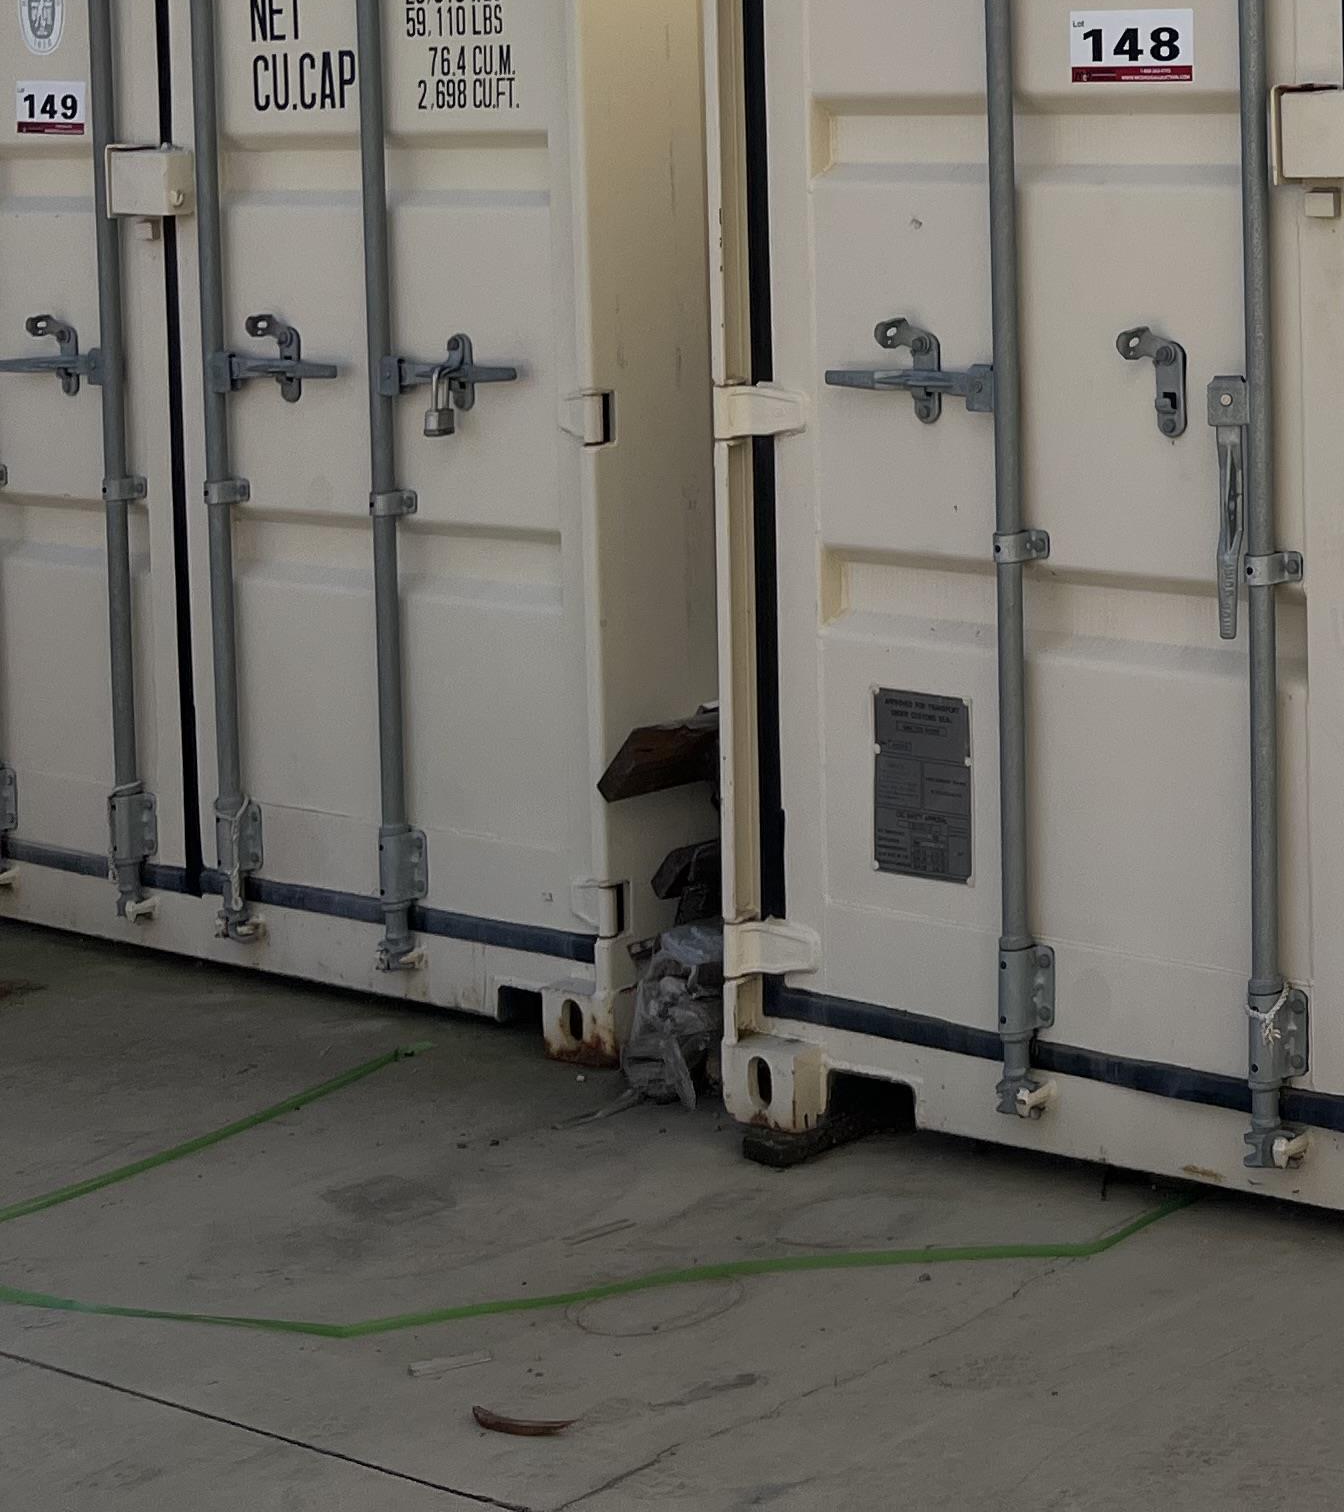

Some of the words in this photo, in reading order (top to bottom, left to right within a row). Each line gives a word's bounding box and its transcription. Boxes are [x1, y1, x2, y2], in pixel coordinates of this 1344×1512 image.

[406, 6, 466, 37] 59,110
[472, 4, 503, 35] LBS
[428, 45, 466, 77] 76.4
[472, 44, 516, 76] CU.M.
[1083, 26, 1180, 62] 148
[23, 93, 78, 120] 149
[418, 79, 467, 110] 2,698
[473, 78, 520, 109] CU.FT.
